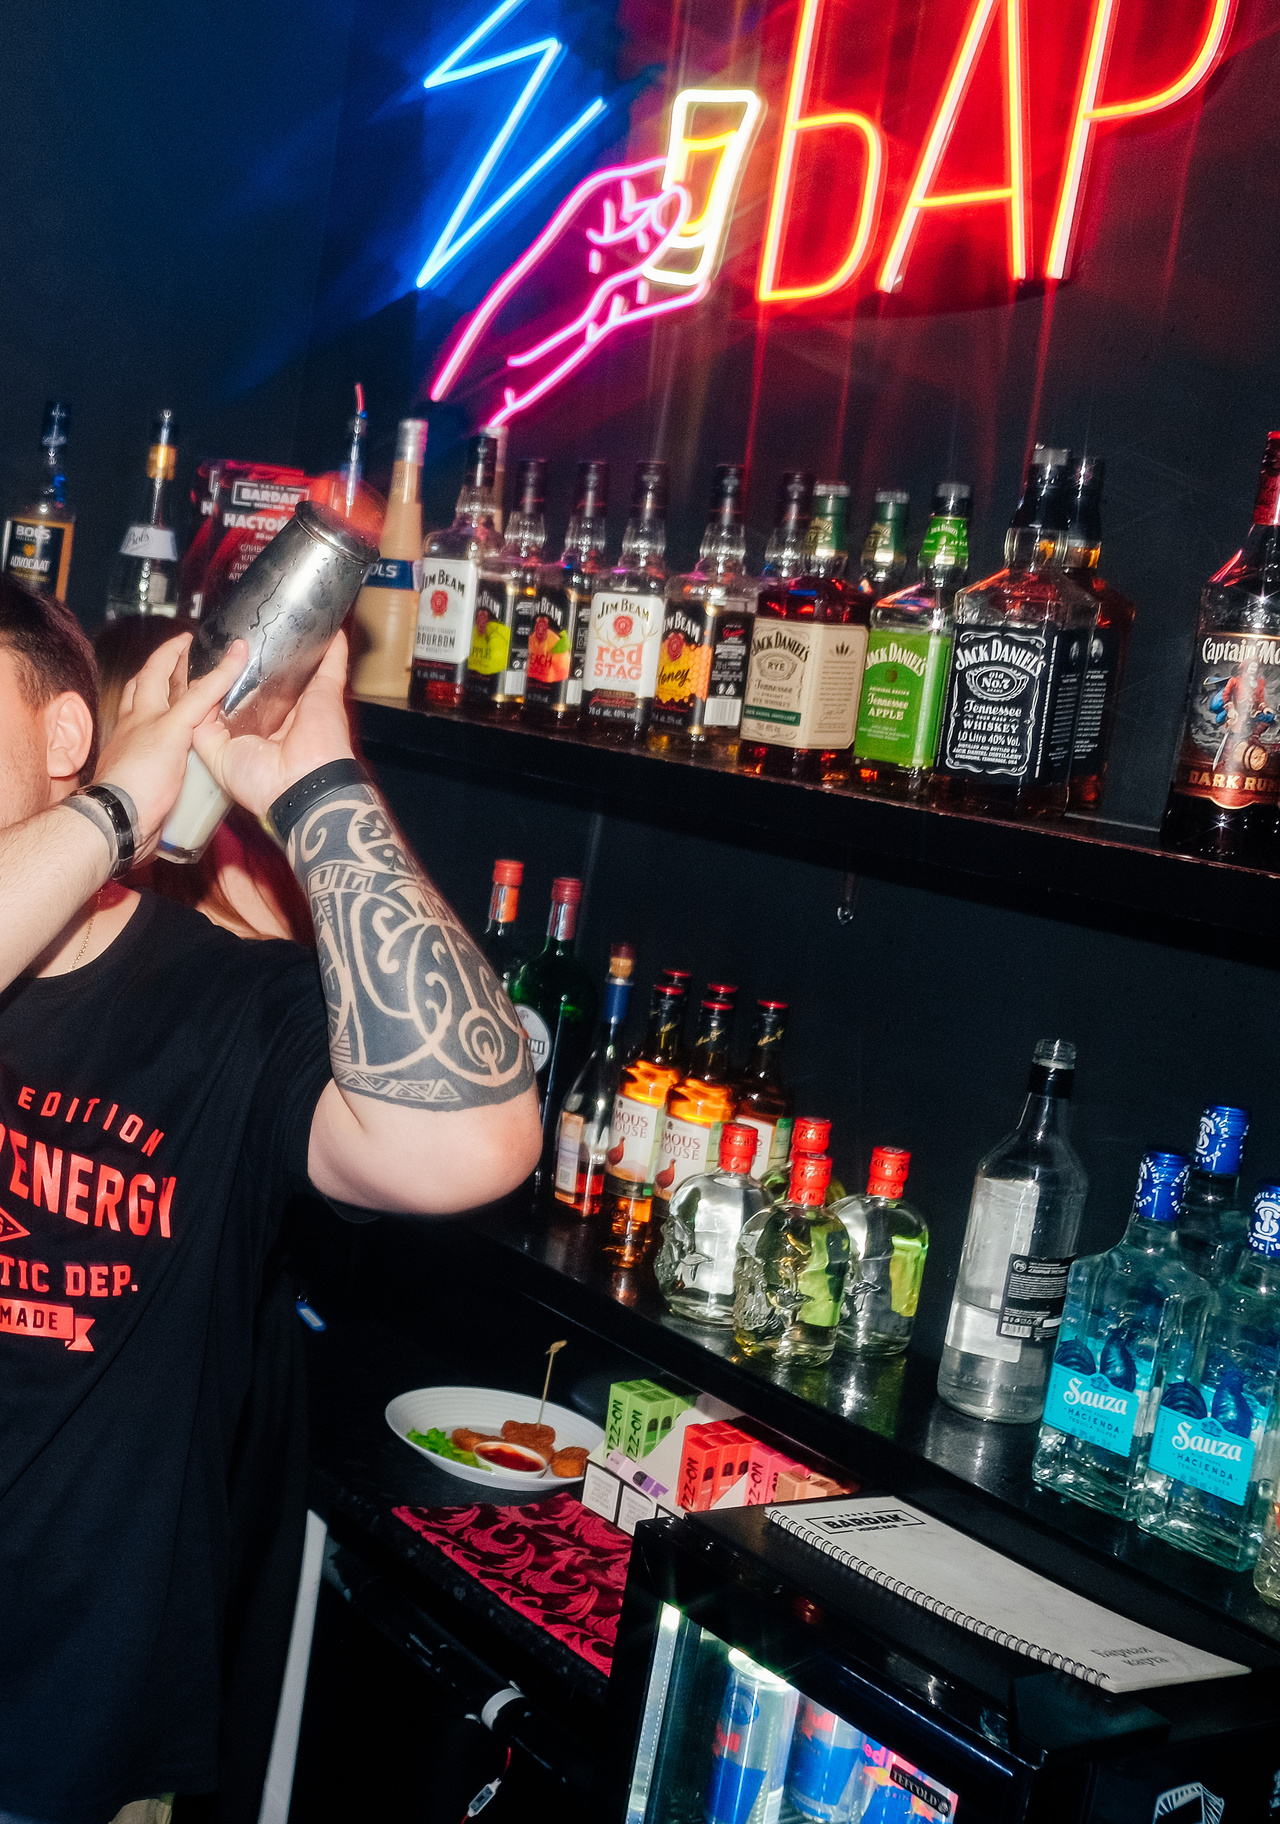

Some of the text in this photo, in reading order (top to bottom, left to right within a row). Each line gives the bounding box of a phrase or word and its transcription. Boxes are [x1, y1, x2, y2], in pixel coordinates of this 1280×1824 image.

[241, 488, 300, 504] BARDAK
[223, 512, 288, 532] НАСТОЙ
[10, 555, 51, 573] ADVOCAAT
[370, 563, 399, 578] OLS
[438, 569, 466, 597] BEAM
[597, 598, 651, 623] JIM BEAM
[663, 611, 701, 645] IM BEAM
[416, 632, 456, 648] BOURBON
[752, 635, 773, 656] JACK
[775, 631, 811, 662] DANIEL'S
[596, 643, 643, 666] red
[888, 642, 927, 677] DANIEL'S
[955, 639, 1047, 677] JACK DANIEL'S
[1202, 637, 1255, 665] Captain
[593, 662, 642, 681] STAG
[766, 661, 786, 672] RYE
[988, 672, 1005, 680] Old
[867, 692, 909, 711] Tennessee
[962, 699, 1023, 718] Tennessee
[868, 707, 905, 721] APPLE
[962, 719, 1020, 734] WHISKEY
[968, 731, 987, 744] Litre
[987, 733, 1006, 746] 40%
[1188, 770, 1241, 790] DARK
[17, 1086, 165, 1157] EDITION
[614, 1109, 649, 1128] MOUS
[613, 1121, 648, 1139] OUSE
[662, 1131, 701, 1150] MOUS
[65, 1263, 139, 1297] DEP.
[0, 1304, 59, 1331] MADE
[1063, 1377, 1128, 1415] Sauza
[1067, 1406, 1120, 1434] HACIENDA
[1171, 1421, 1243, 1462] Sauza
[1177, 1454, 1234, 1481] HACIENDA
[822, 1513, 908, 1529] BARDAK
[892, 1769, 939, 1806] TEFCOLD
